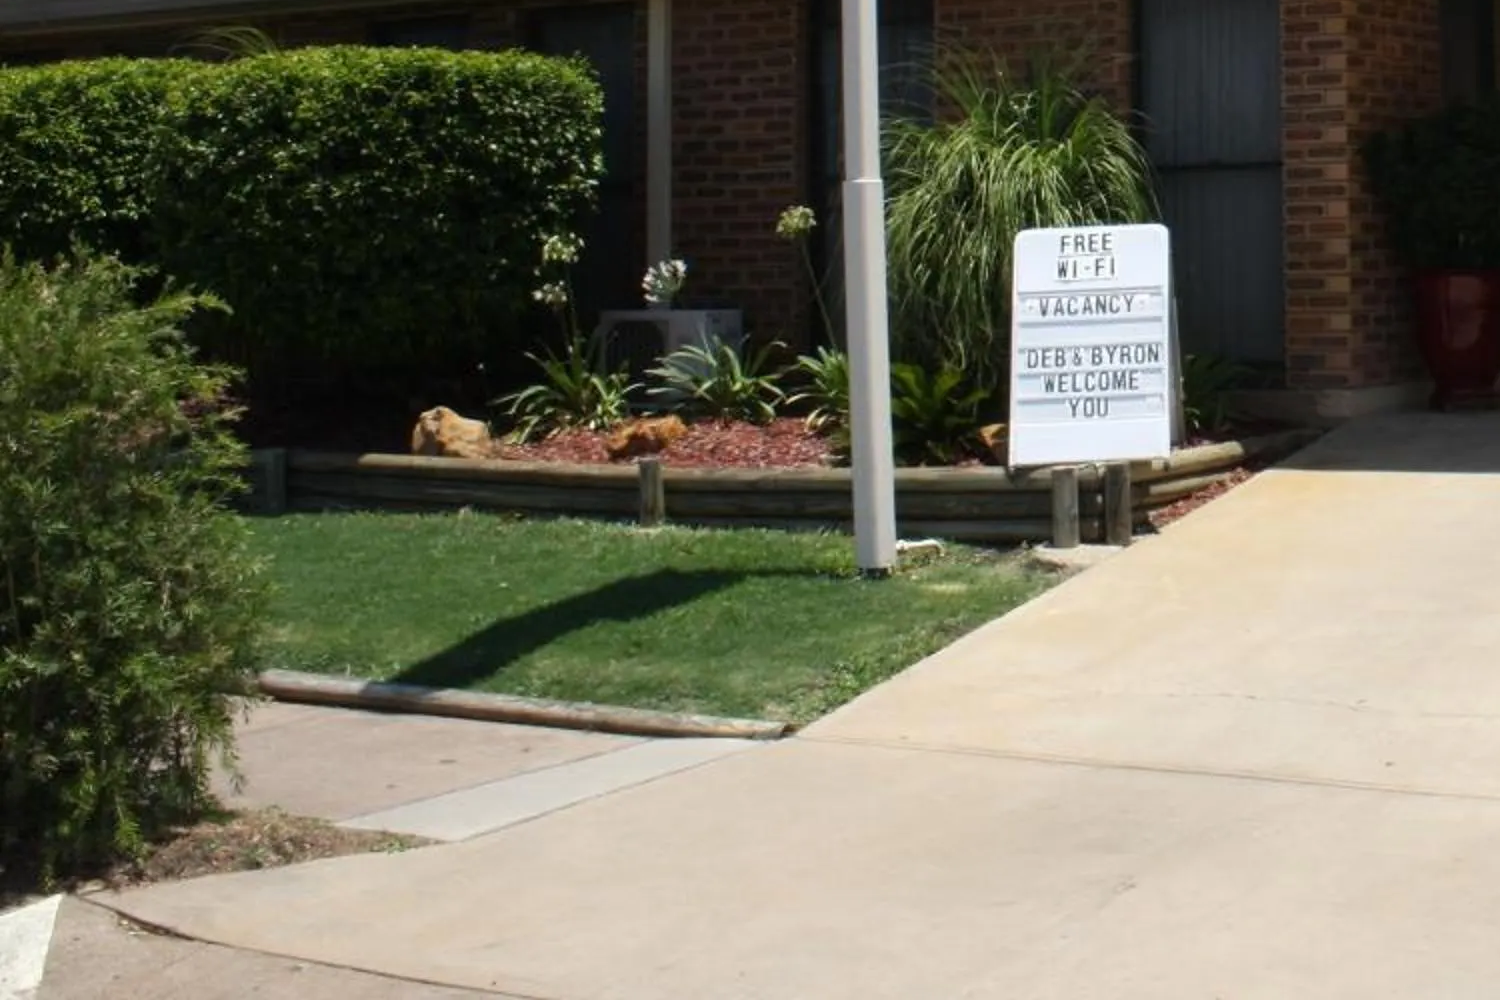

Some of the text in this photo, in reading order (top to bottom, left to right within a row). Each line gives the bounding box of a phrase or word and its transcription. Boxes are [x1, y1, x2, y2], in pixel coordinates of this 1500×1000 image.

[1060, 233, 1113, 253] FREE
[1057, 258, 1116, 279] WI-FI
[1039, 294, 1135, 317] VACANCY
[1026, 344, 1160, 369] DEB & BYRON
[1043, 371, 1141, 393] WELCOME
[1067, 397, 1110, 418] YOU
